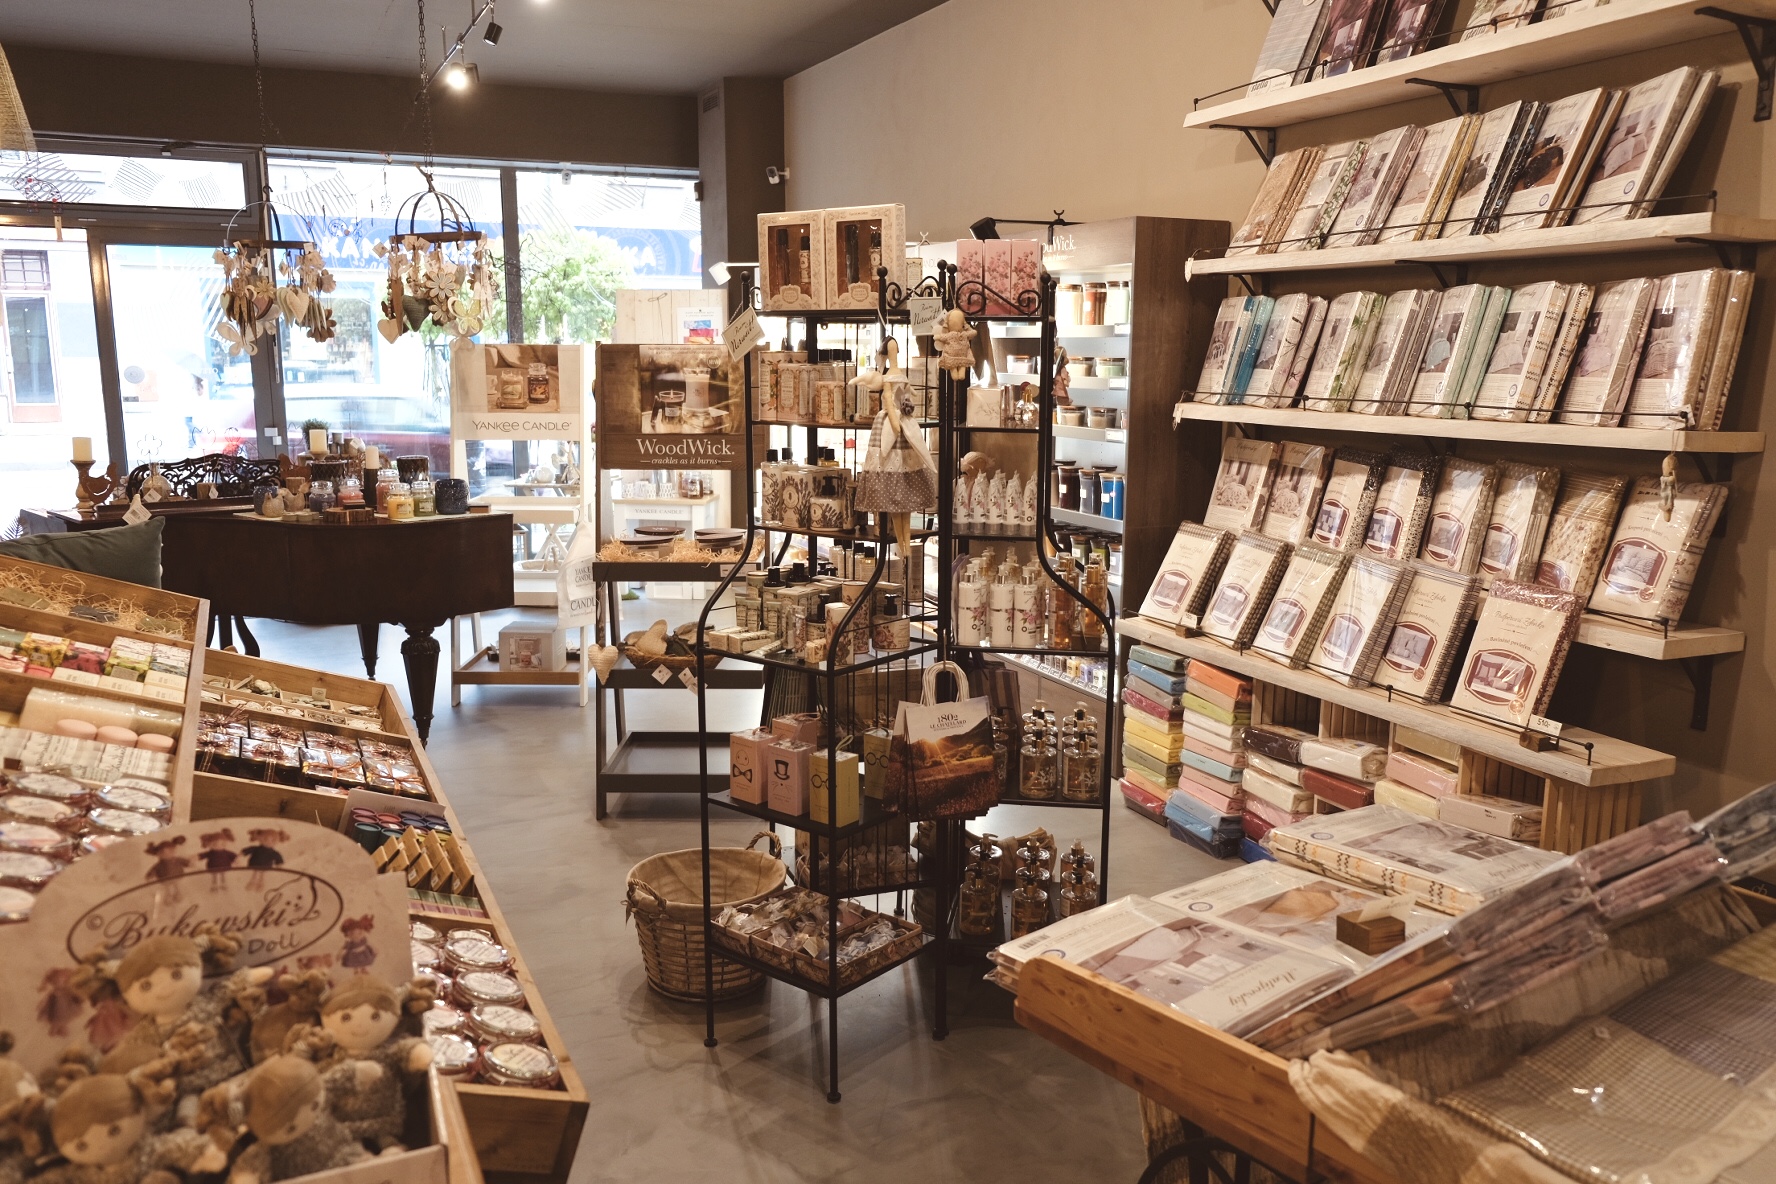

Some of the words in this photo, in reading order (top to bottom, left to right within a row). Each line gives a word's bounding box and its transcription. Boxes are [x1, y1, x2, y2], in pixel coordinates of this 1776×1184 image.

[651, 457, 678, 465] crackles
[690, 457, 696, 465] it
[697, 457, 718, 465] burns
[575, 566, 592, 576] YANKE
[575, 574, 593, 583] CANDL
[570, 597, 596, 611] CANDL
